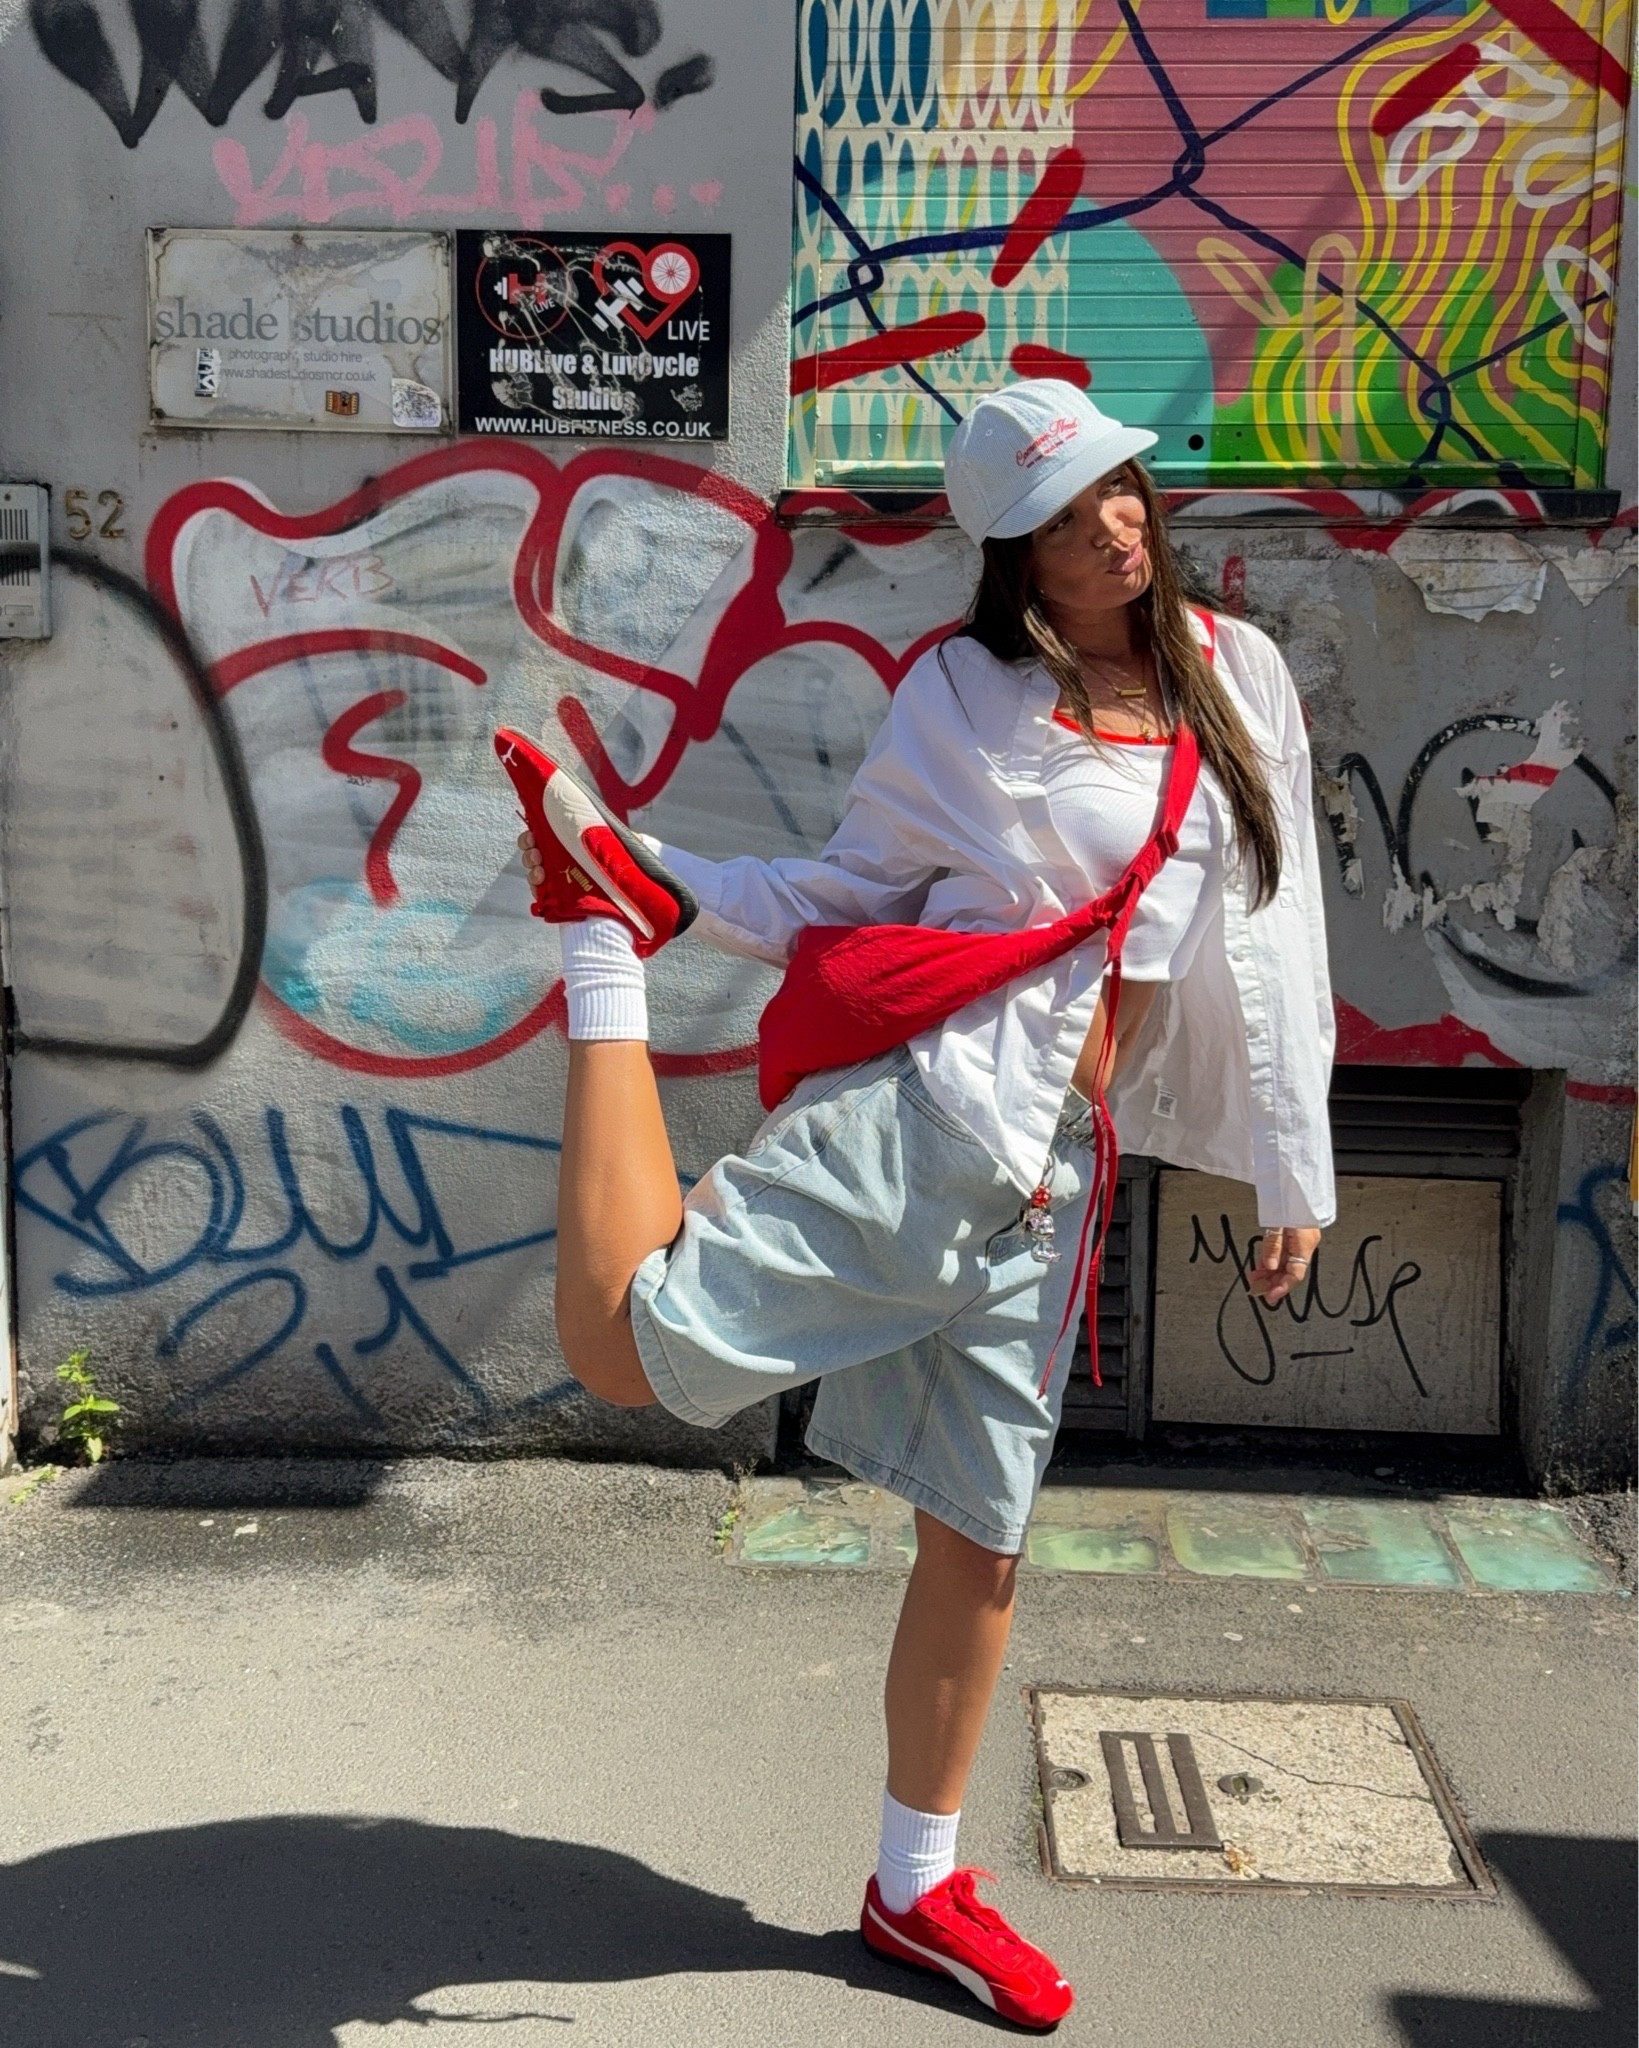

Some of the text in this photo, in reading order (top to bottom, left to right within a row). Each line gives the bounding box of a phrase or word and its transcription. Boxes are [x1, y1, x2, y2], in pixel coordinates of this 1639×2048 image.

[156, 297, 442, 345] shade studios
[667, 320, 710, 341] LIVE
[303, 350, 339, 363] studio
[340, 351, 363, 364] hire
[581, 353, 599, 375] &
[474, 417, 712, 438] WWW.HUBFITNESS.CO.UK
[65, 488, 126, 540] 52
